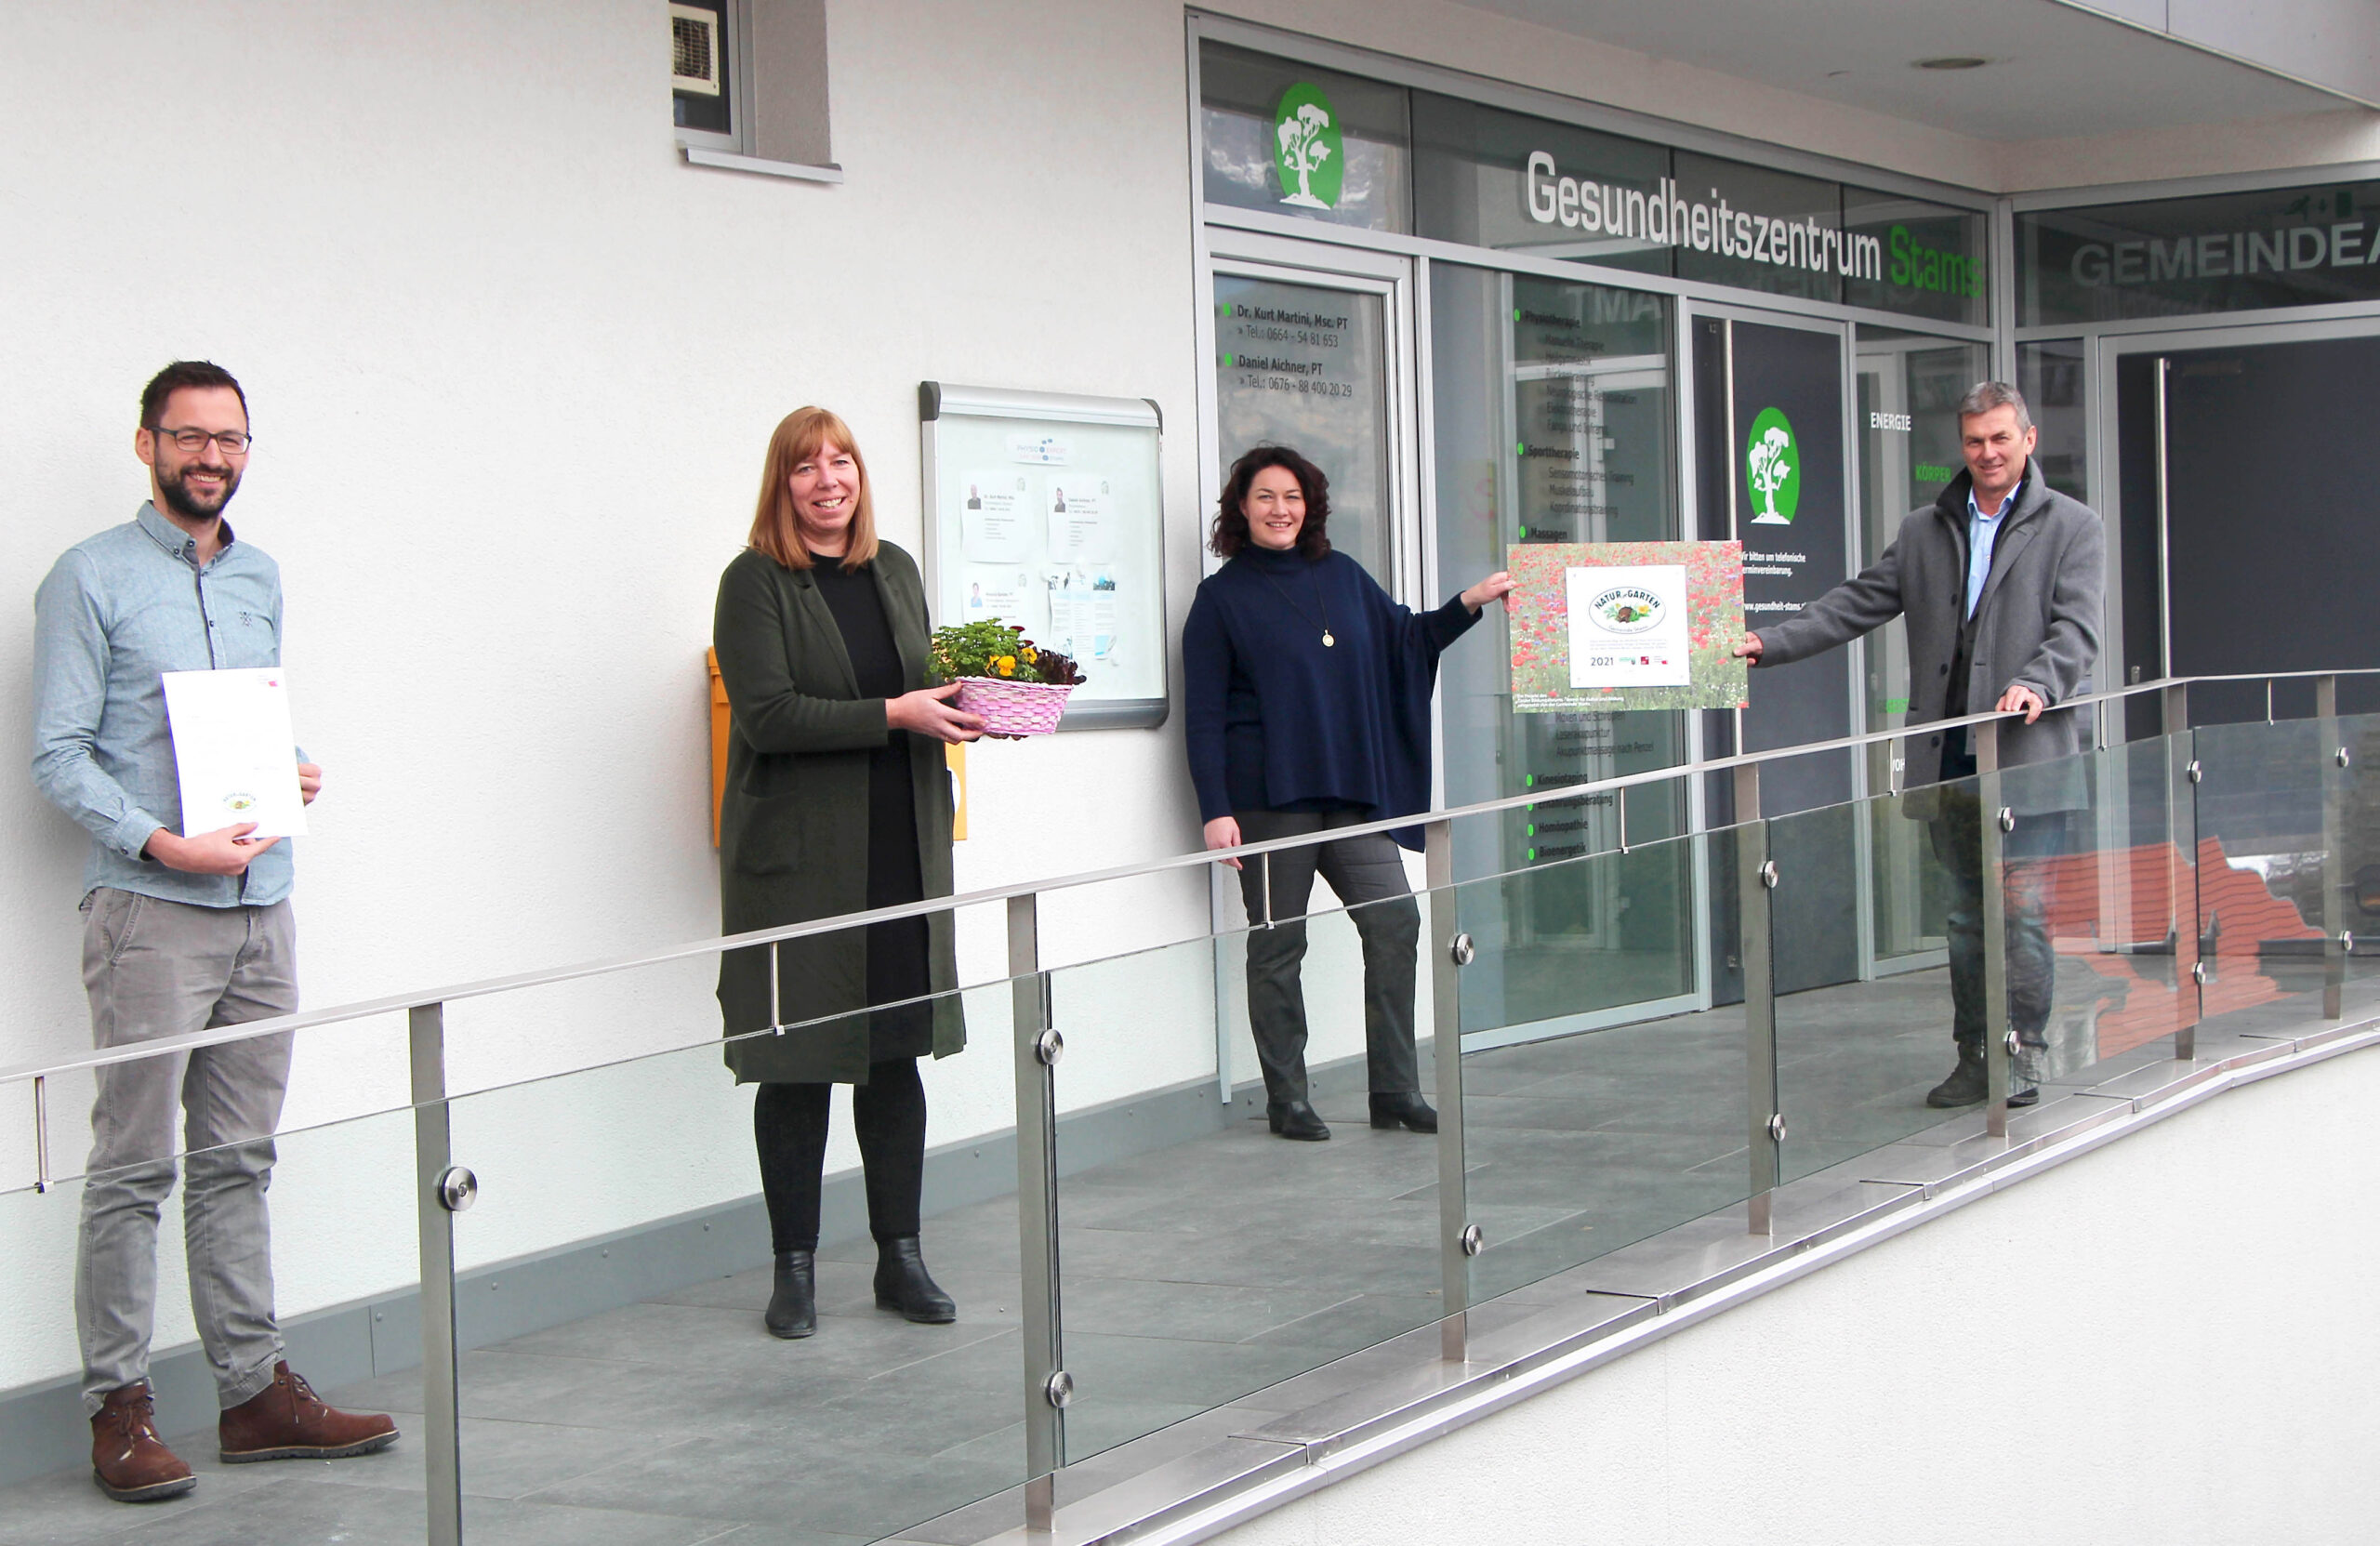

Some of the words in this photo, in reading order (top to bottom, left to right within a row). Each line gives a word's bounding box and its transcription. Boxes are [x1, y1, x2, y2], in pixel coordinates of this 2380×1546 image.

[1527, 150, 1882, 283] Gesundheitszentrum
[1890, 225, 1984, 298] Stams
[1236, 304, 1251, 318] Dr.
[1254, 306, 1275, 322] Kurt
[1276, 310, 1312, 328] Martini,
[1314, 314, 1334, 329] Msc.
[1337, 316, 1349, 330] PT
[1246, 324, 1264, 339] Tel.:
[1267, 327, 1288, 341] 0664
[1297, 330, 1308, 344] 54
[1310, 332, 1320, 347] 81
[1323, 334, 1339, 349] 653
[1238, 354, 1268, 371] Daniel
[1271, 358, 1309, 377] Aichner,
[1311, 363, 1323, 377] PT
[1247, 374, 1265, 389] Tel.:
[1268, 377, 1290, 391] 0676
[1298, 379, 1309, 393] 88
[1311, 380, 1327, 395] 400
[1329, 382, 1340, 397] 20
[1342, 384, 1353, 398] 29
[1871, 411, 1911, 432] ENERGIE
[1527, 443, 1580, 462] Sporttherapie
[1915, 460, 1951, 482] KÖRPER
[1530, 527, 1568, 542] Massagen
[1749, 550, 1765, 562] bitten
[1765, 553, 1775, 562] um
[1775, 551, 1806, 563] telefonische
[1593, 589, 1621, 610] NATUR
[1627, 588, 1661, 610] GARTEN
[1590, 656, 1615, 667] 2021
[1539, 842, 1586, 858] Bioenergetik
